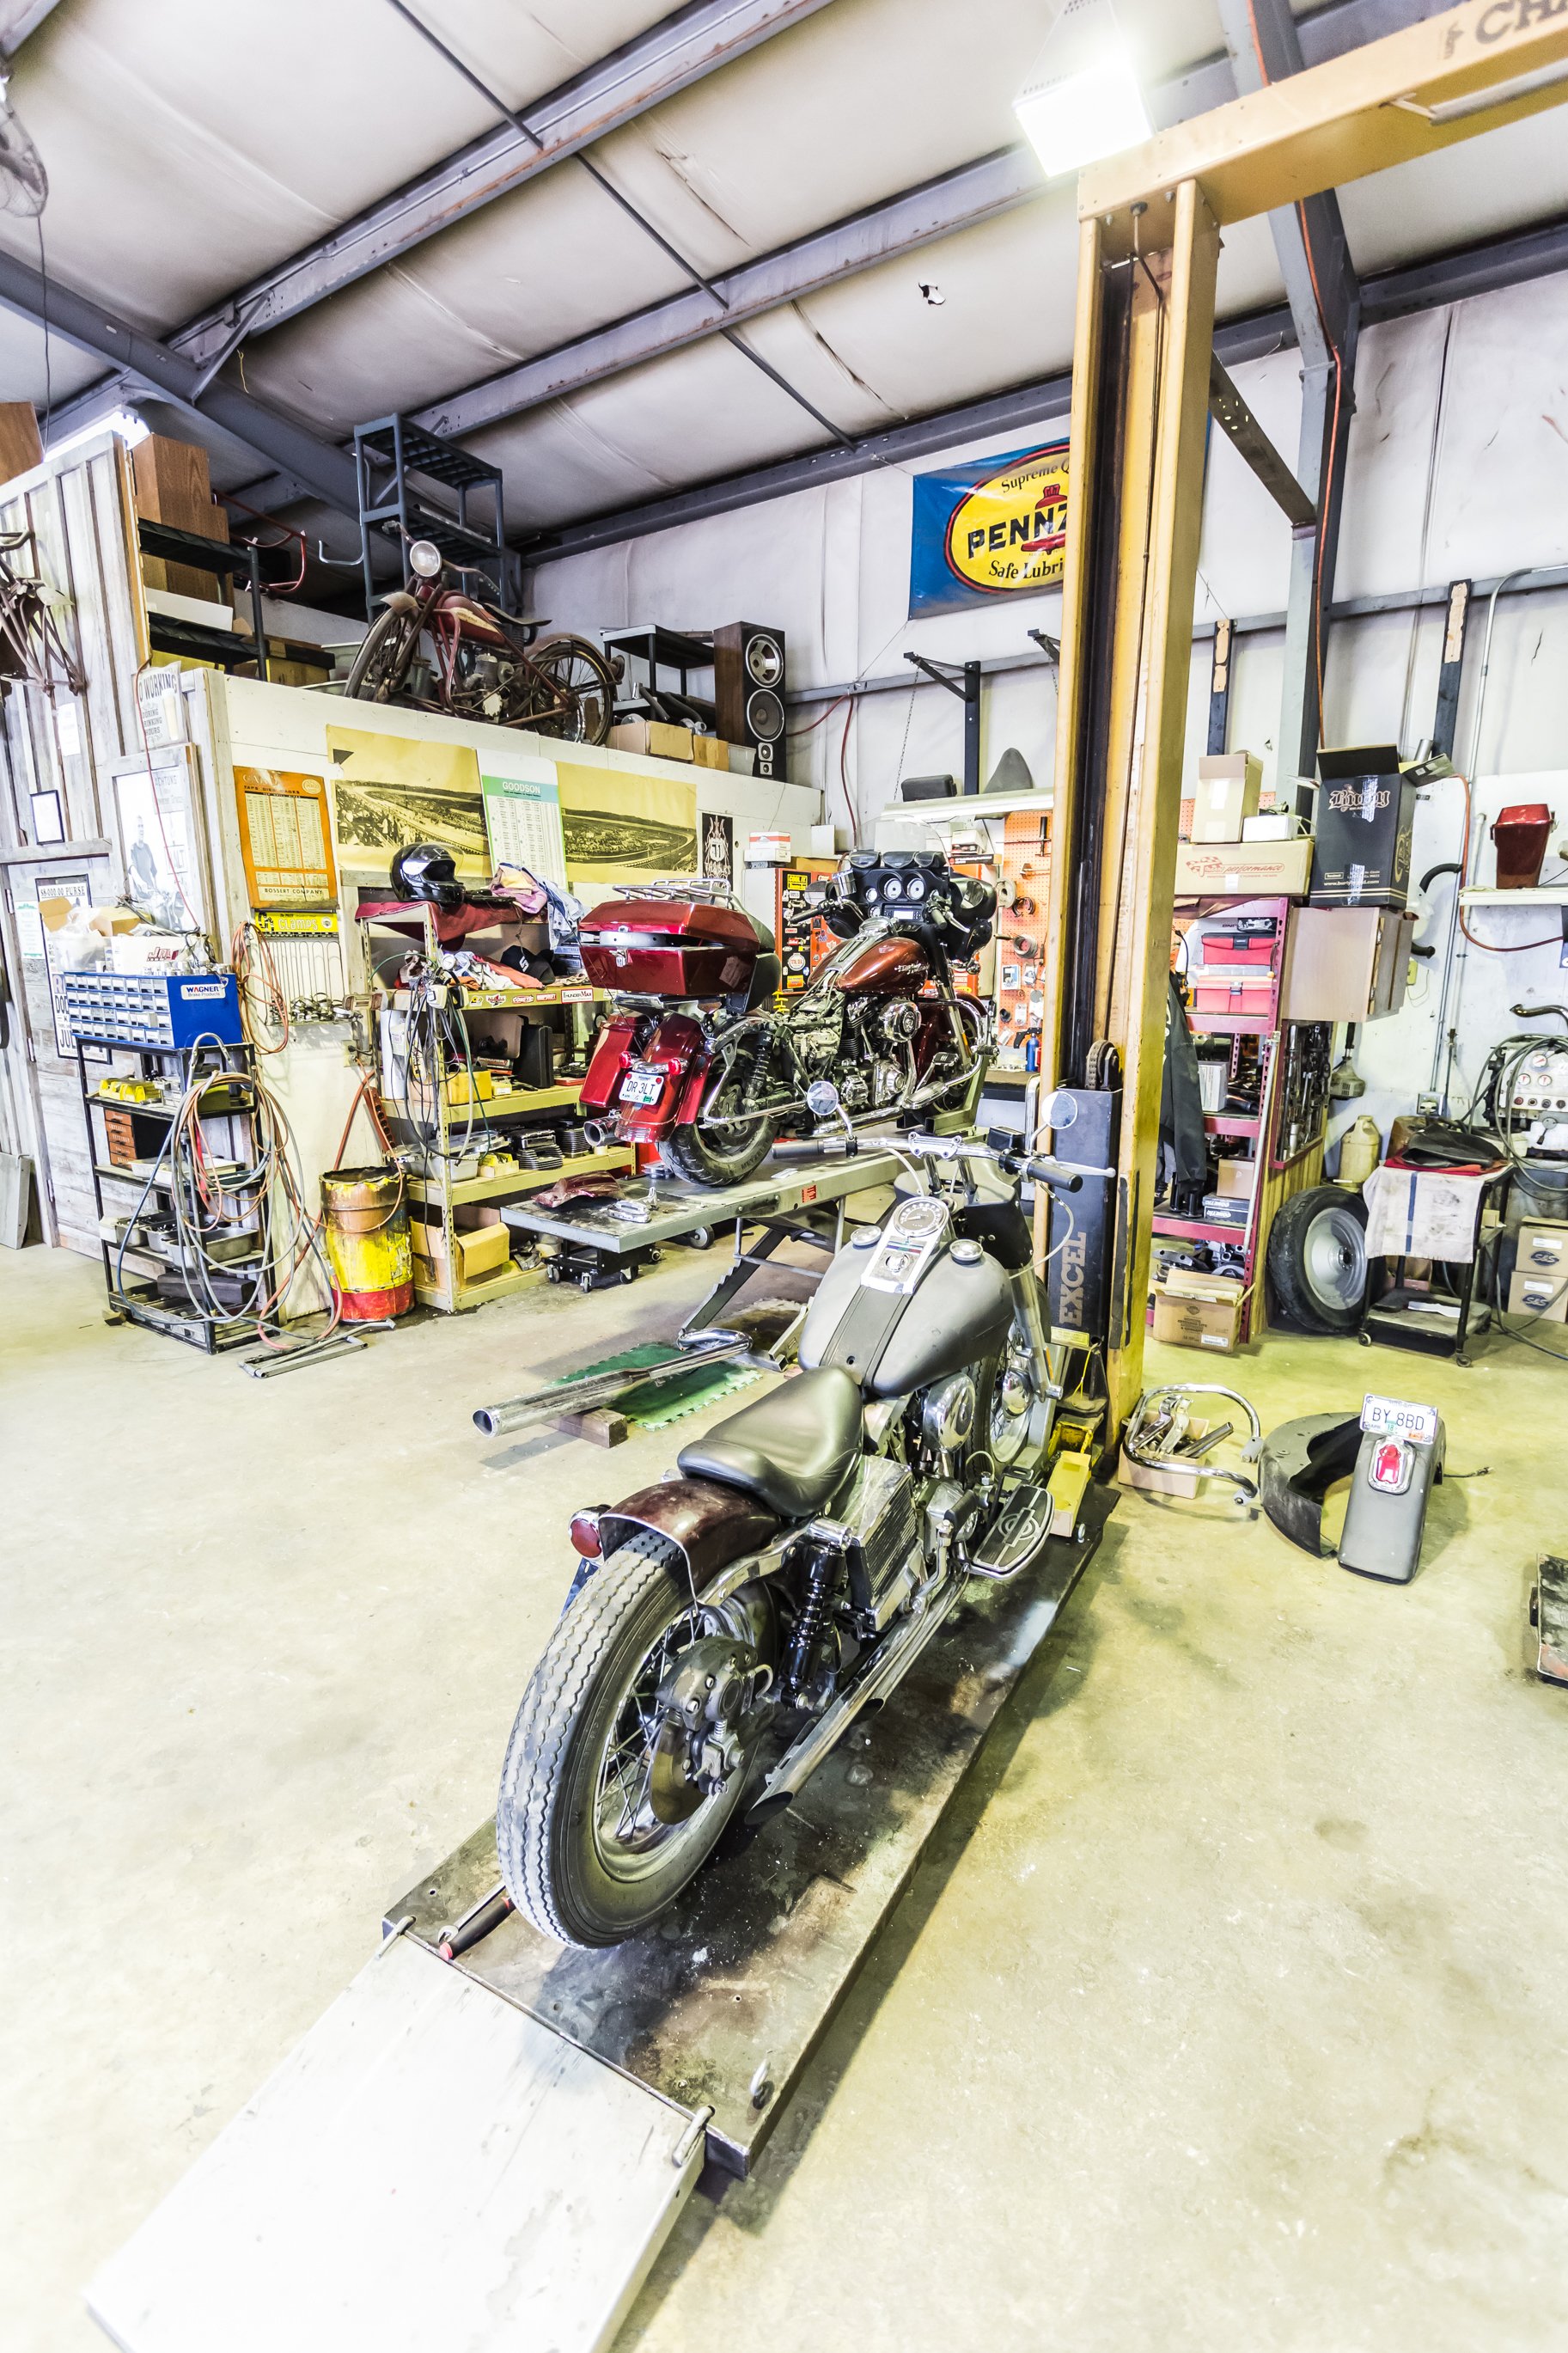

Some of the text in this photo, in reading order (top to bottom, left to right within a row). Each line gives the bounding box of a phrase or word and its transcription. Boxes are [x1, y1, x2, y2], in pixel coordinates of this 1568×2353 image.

[1001, 465, 1059, 493] Supreme
[967, 503, 1067, 559] PENNZ
[989, 558, 1064, 579] Safe Lubri
[143, 673, 177, 700] WORKING
[502, 781, 541, 794] GOODSON
[65, 885, 85, 895] PURSE
[626, 1080, 656, 1095] DR 3LT
[1059, 1231, 1087, 1328] EXCEL
[1372, 1407, 1425, 1431] BY 8BD
